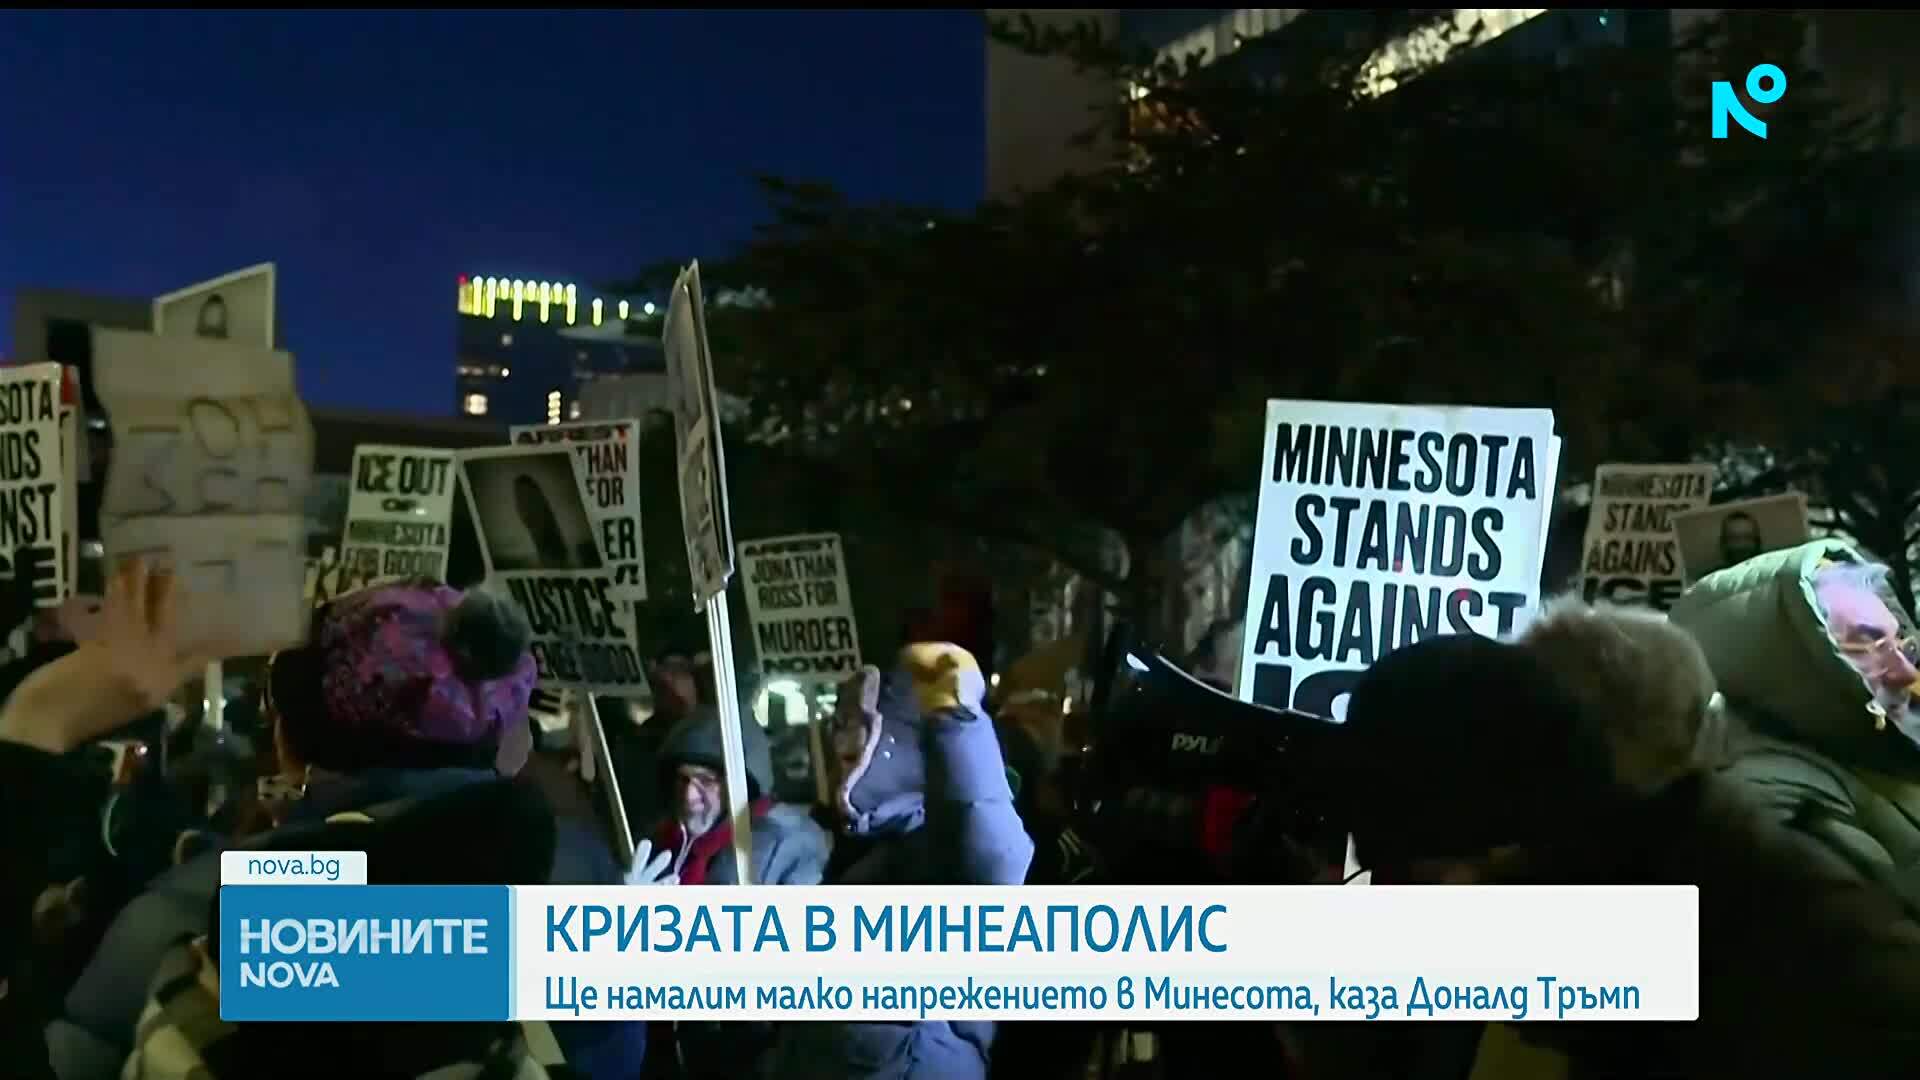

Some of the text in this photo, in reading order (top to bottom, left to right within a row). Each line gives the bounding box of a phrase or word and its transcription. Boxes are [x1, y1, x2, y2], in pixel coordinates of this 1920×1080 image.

[357, 455, 451, 496] ICE OUT
[1273, 423, 1536, 499] MINNESOTA
[1290, 494, 1503, 580] STANDS
[1585, 540, 1676, 576] AGAINS
[804, 581, 839, 606] FOR
[757, 616, 853, 654] MURDER
[1254, 574, 1526, 665] AGAINST
